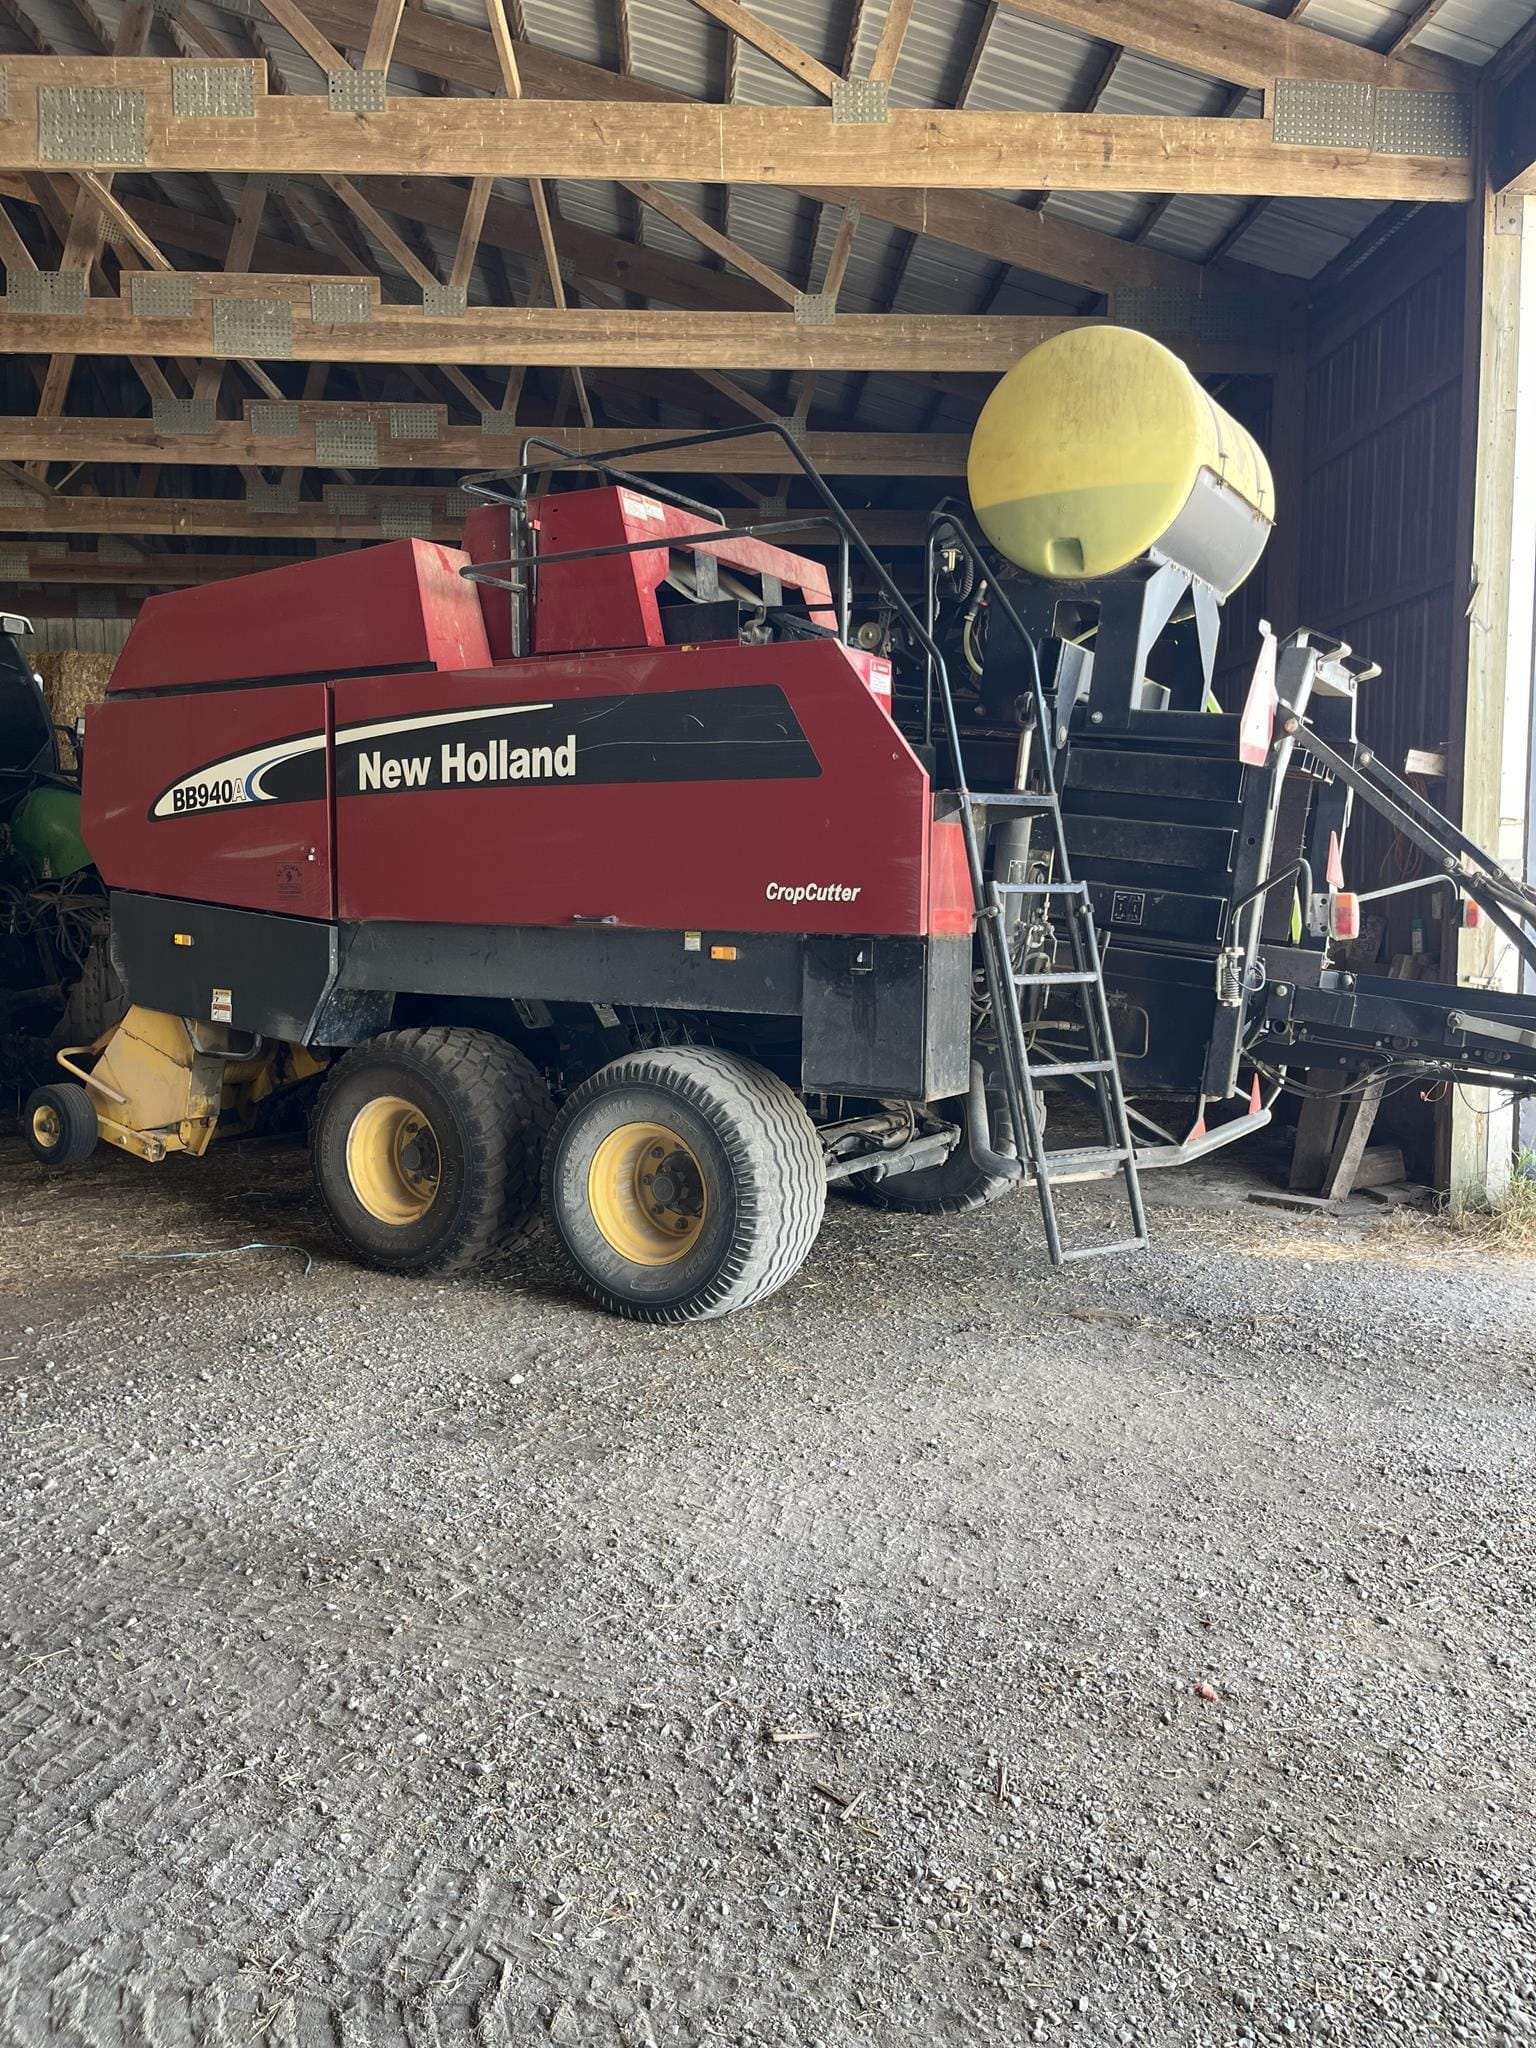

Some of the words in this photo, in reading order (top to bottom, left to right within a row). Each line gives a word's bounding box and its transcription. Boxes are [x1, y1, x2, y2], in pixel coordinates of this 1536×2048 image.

[358, 751, 432, 791] New
[441, 734, 577, 784] Holland
[173, 777, 247, 812] BB940A
[765, 882, 862, 905] CropCutter
